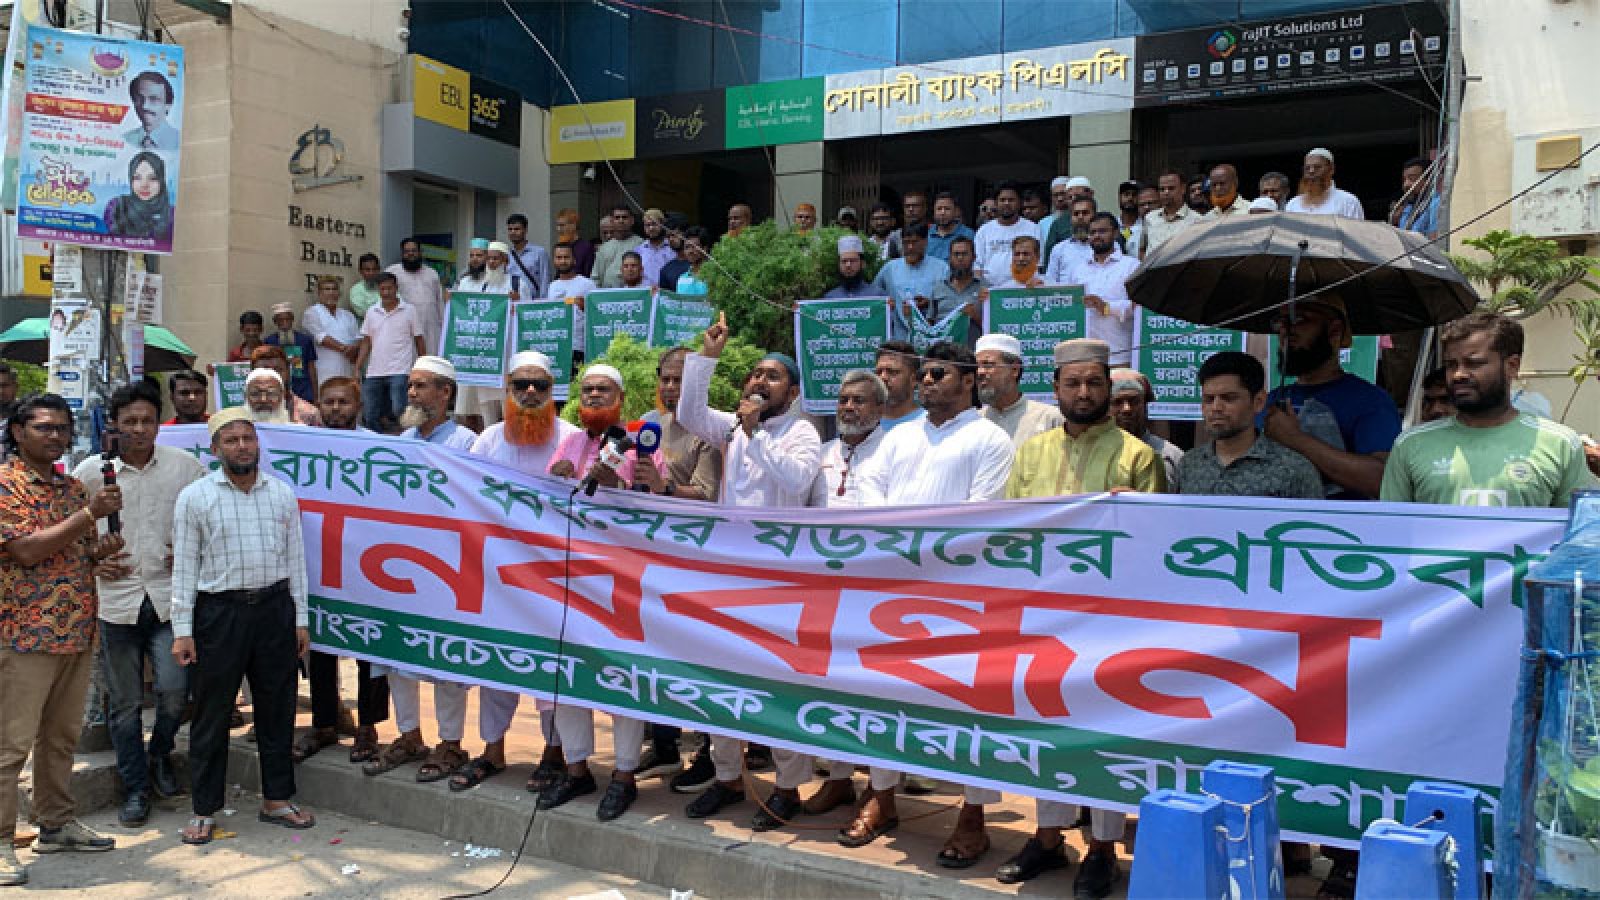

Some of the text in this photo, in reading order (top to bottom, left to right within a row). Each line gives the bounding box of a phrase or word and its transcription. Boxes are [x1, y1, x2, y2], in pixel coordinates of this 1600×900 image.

[1274, 20, 1337, 37] Solutions
[1340, 13, 1363, 29] Ltd
[440, 82, 465, 111] EBL
[927, 70, 1004, 102] ব্যাংক
[288, 204, 366, 238] Eastern
[300, 240, 353, 268] Bank
[268, 446, 456, 509] ব্যাংকিং
[752, 519, 1134, 580] ষড়যন্ত্রের
[296, 496, 1382, 749] ানববন্ধন
[308, 603, 389, 647] াংক
[399, 622, 584, 688] সচেতন
[595, 660, 774, 722] গ্রাহক
